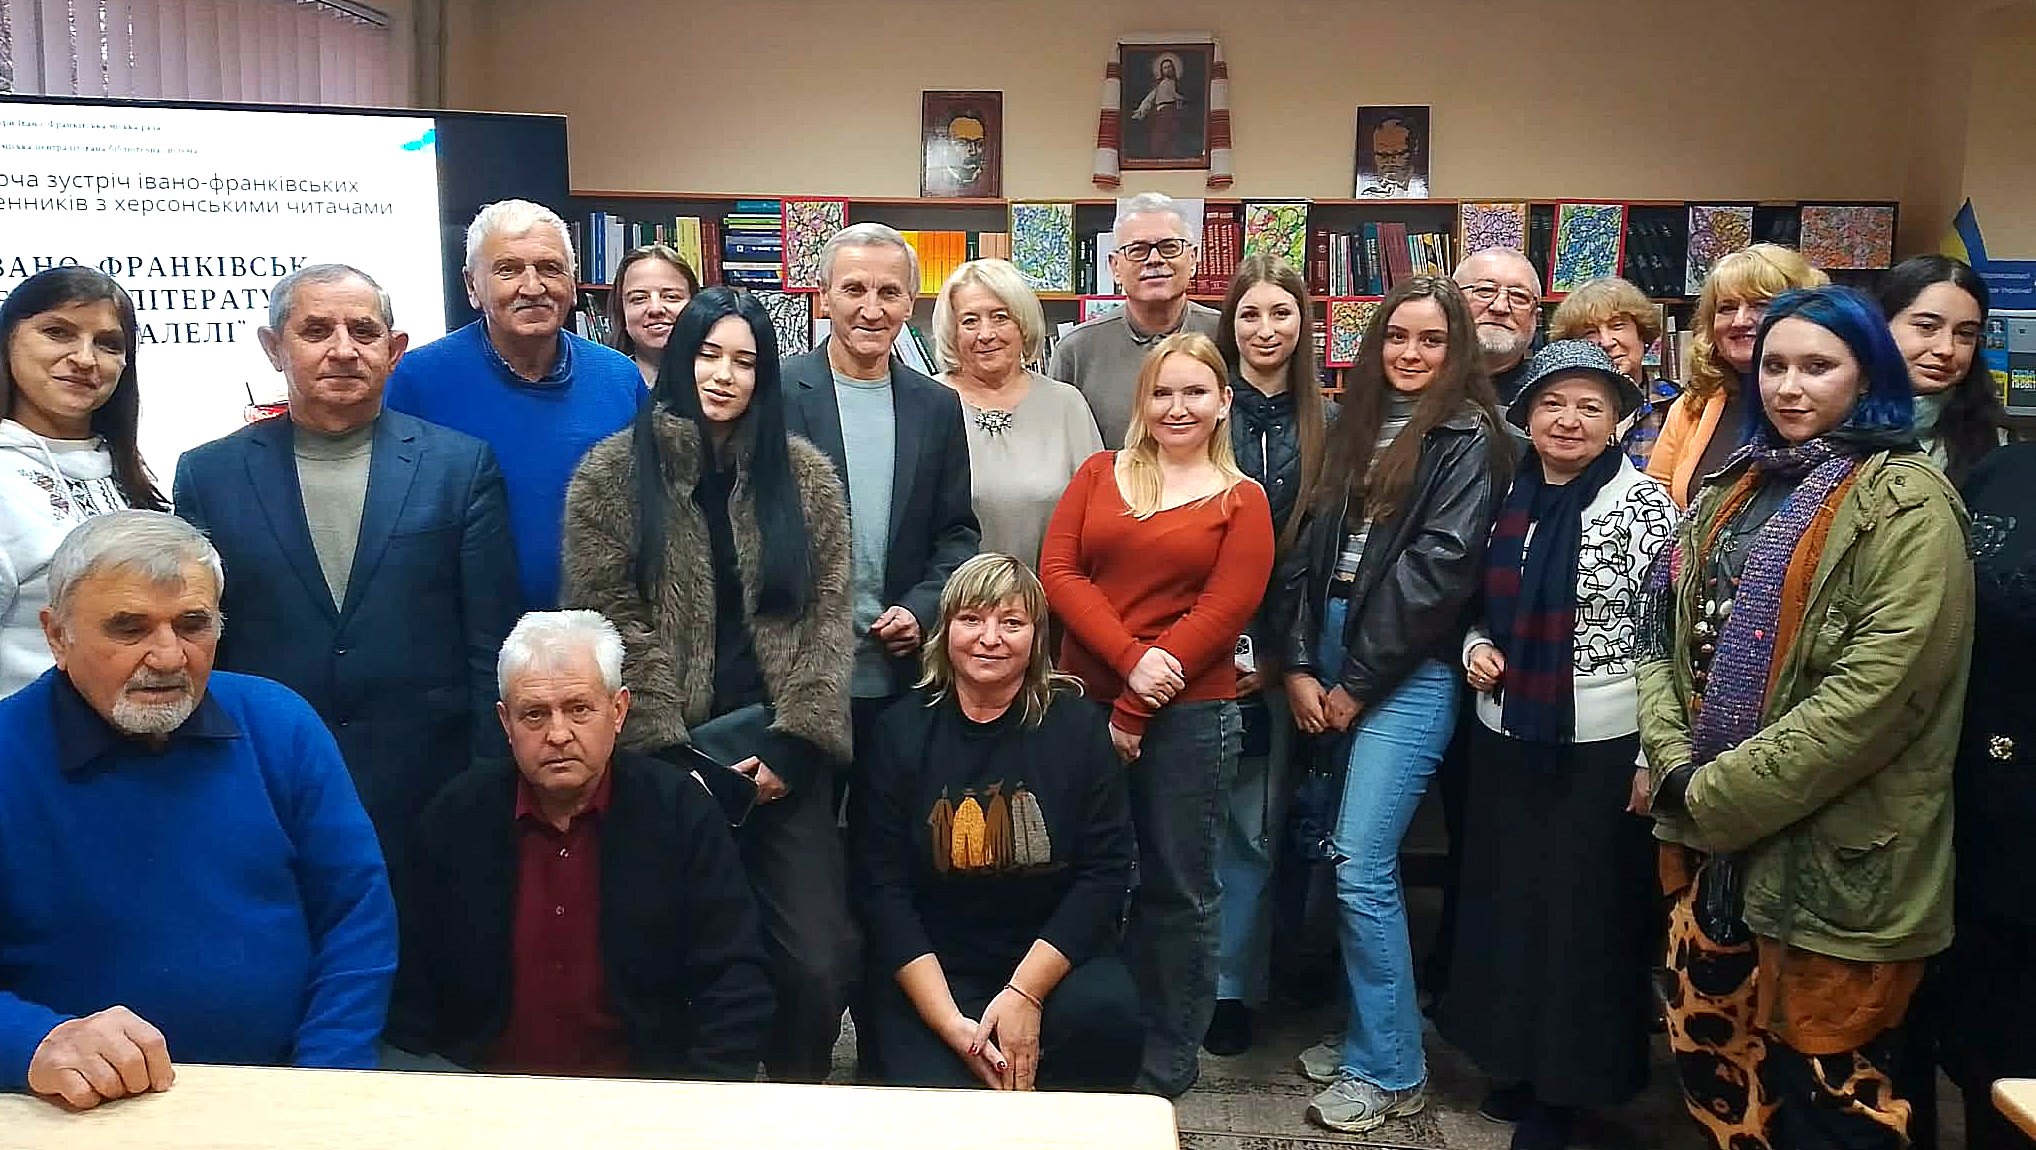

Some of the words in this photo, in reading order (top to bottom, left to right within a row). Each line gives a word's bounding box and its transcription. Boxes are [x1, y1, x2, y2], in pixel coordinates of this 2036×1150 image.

[164, 147, 198, 155] истема
[0, 173, 39, 188] оча
[47, 173, 130, 194] зустріч
[138, 172, 359, 196] івано-франківських
[96, 198, 107, 212] з
[115, 198, 279, 217] херсонськими
[287, 201, 393, 215] читачами
